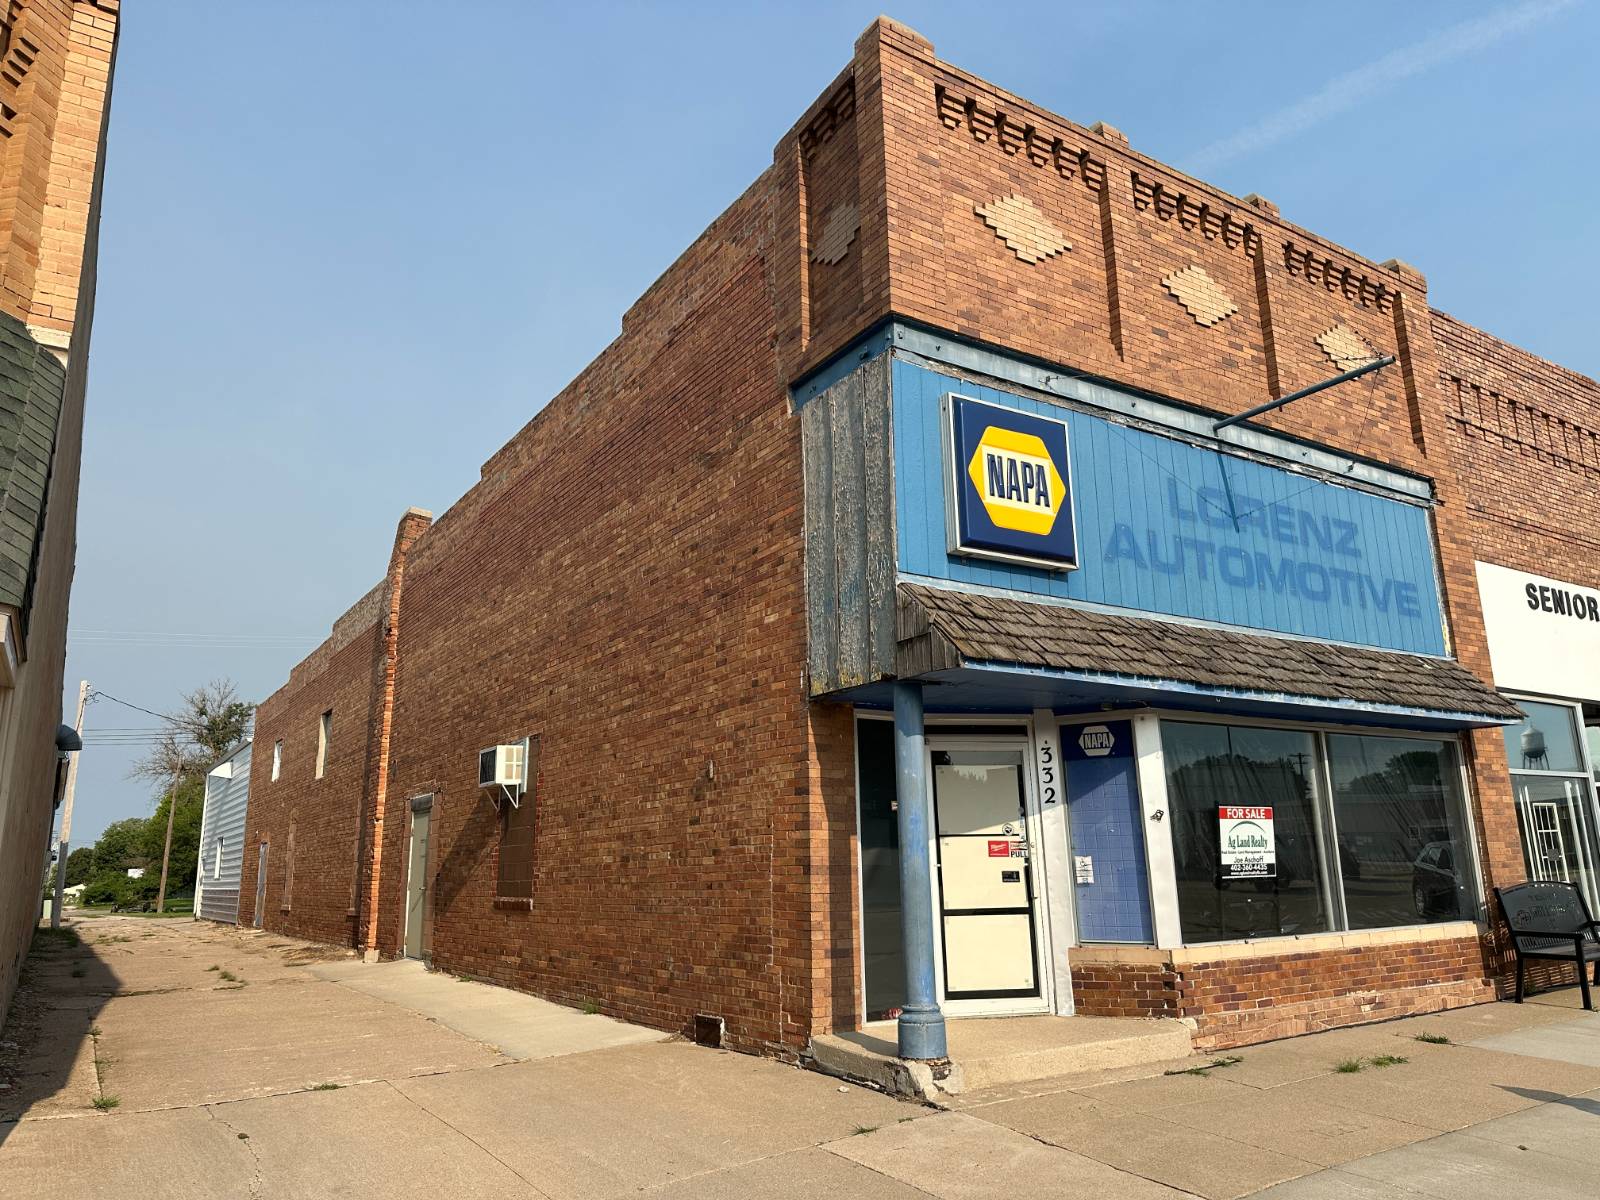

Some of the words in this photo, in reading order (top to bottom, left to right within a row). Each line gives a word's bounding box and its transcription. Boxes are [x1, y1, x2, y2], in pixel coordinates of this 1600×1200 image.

[986, 453, 1050, 508] NAPA
[1167, 477, 1362, 558] LORENZ
[1103, 522, 1422, 618] AUTOMOTIVE
[1525, 582, 1600, 622] SENIOR
[1083, 731, 1110, 750] NAPA
[1040, 746, 1056, 804] 332
[1226, 808, 1244, 819] FOR
[1245, 808, 1266, 819] SALE
[1010, 850, 1028, 858] PULL
[1228, 835, 1236, 849] Ag
[1237, 834, 1250, 848] Land
[1251, 834, 1267, 849] Realty
